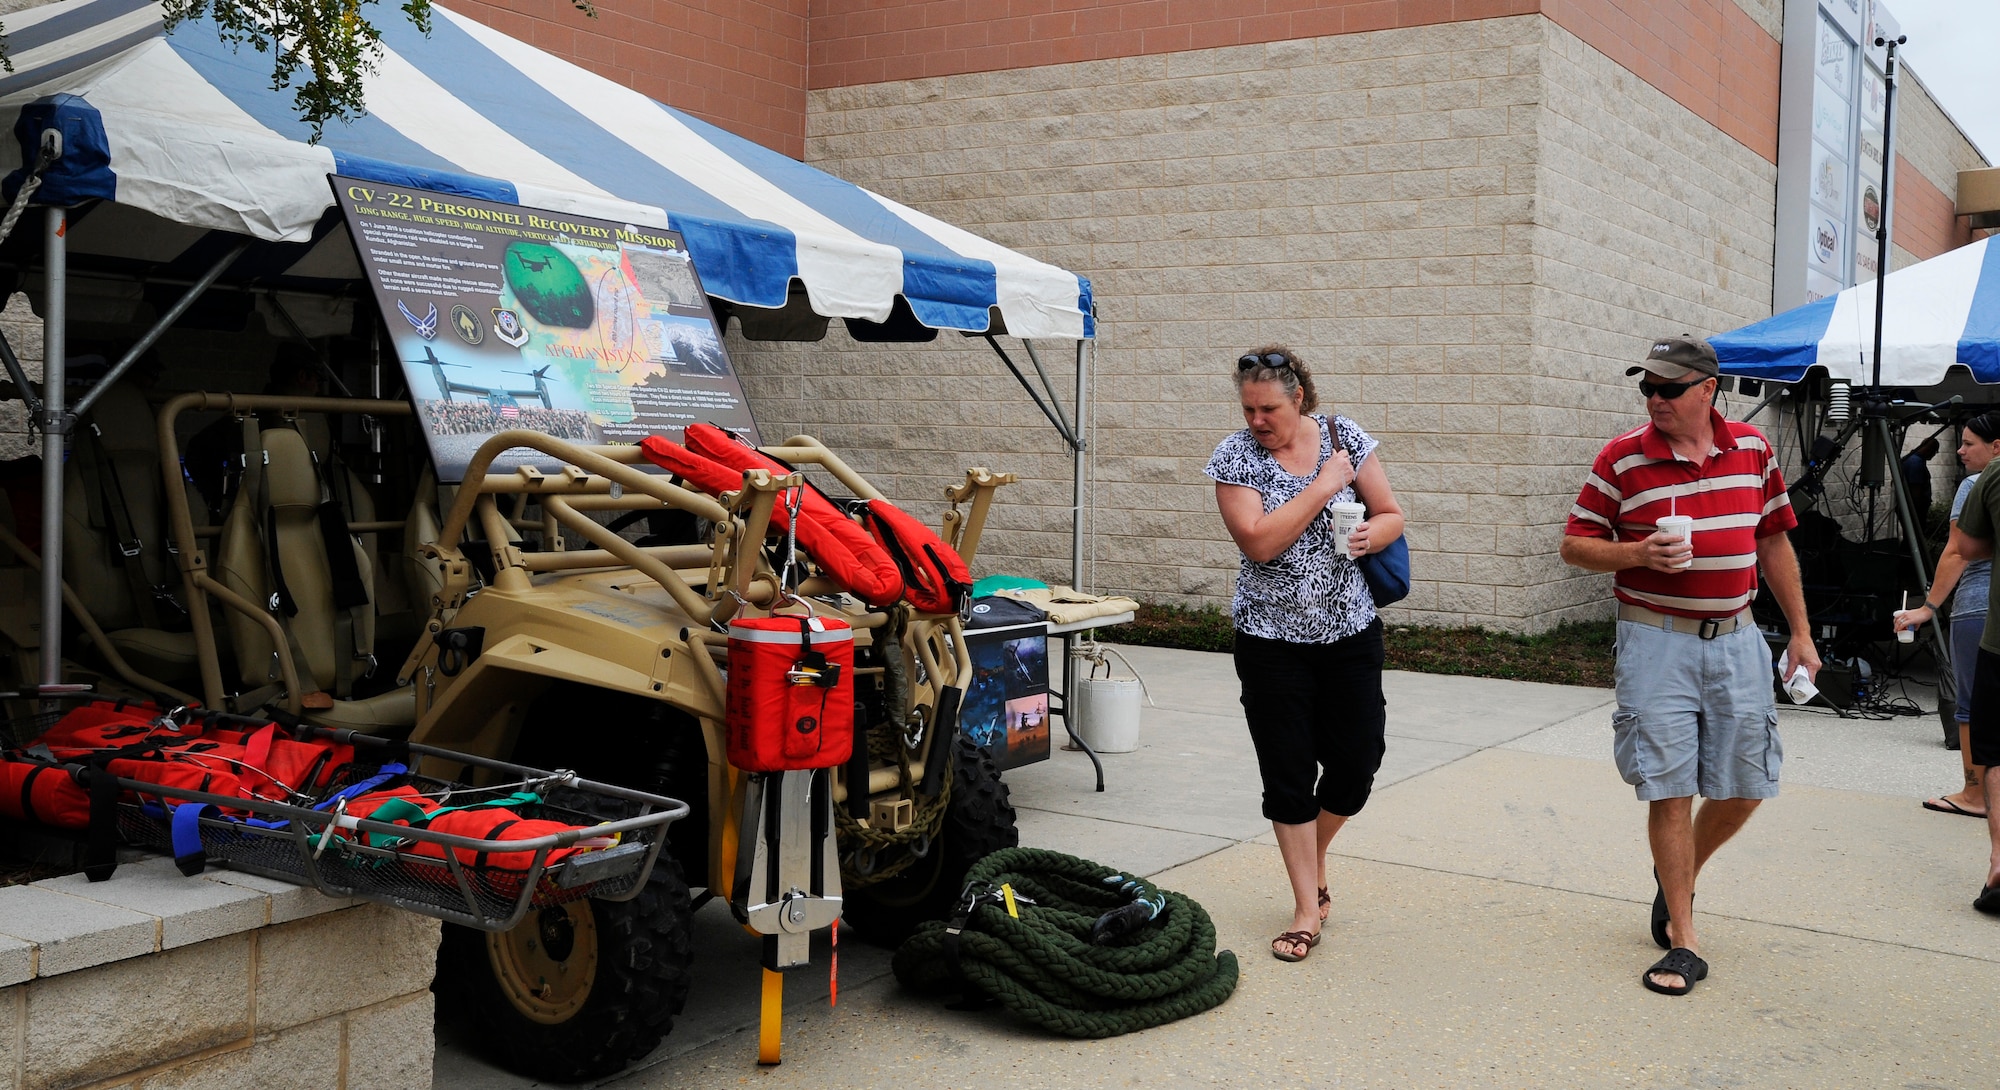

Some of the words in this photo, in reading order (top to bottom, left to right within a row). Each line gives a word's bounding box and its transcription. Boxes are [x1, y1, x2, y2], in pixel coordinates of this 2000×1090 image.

[348, 186, 415, 209] CV-22
[419, 197, 524, 226] PERSONNEL
[528, 215, 611, 240] RECOVERY
[615, 228, 677, 250] MISSION
[354, 204, 380, 217] LONG
[380, 209, 412, 222] RANGE,
[413, 214, 435, 225] HIGH
[435, 217, 463, 230] SPEED,
[463, 221, 485, 232] HIGH
[486, 225, 523, 238] ALTITUDE,
[572, 238, 618, 251] EXFILTRATION
[360, 220, 370, 228] On
[373, 222, 386, 230] June
[403, 227, 424, 235] coalition
[423, 229, 447, 239] helicopter
[447, 233, 474, 243] conducting
[365, 234, 387, 244] Kunduz,
[387, 237, 418, 248] Afghanistan.
[381, 231, 408, 240] operations
[428, 237, 449, 245] disabled
[460, 241, 474, 249] target
[1817, 226, 1836, 252] Optical
[370, 248, 394, 257] Stranded
[399, 251, 409, 259] the
[475, 261, 488, 270] party
[402, 259, 416, 267] arms
[425, 262, 442, 270] mortar
[377, 268, 393, 276] Other
[393, 270, 411, 278] theater
[410, 272, 429, 280] aircraft
[442, 277, 462, 285] multiple
[478, 280, 500, 289] attempts,
[415, 280, 442, 289] successful
[458, 285, 475, 293] rugged
[545, 343, 645, 363] AFGHANISTAN
[639, 386, 658, 394] Squadron
[637, 400, 659, 408] penetrating
[658, 401, 681, 409] dangerously
[699, 402, 715, 410] visibility
[602, 429, 622, 437] requiring
[615, 422, 642, 430] accomplished
